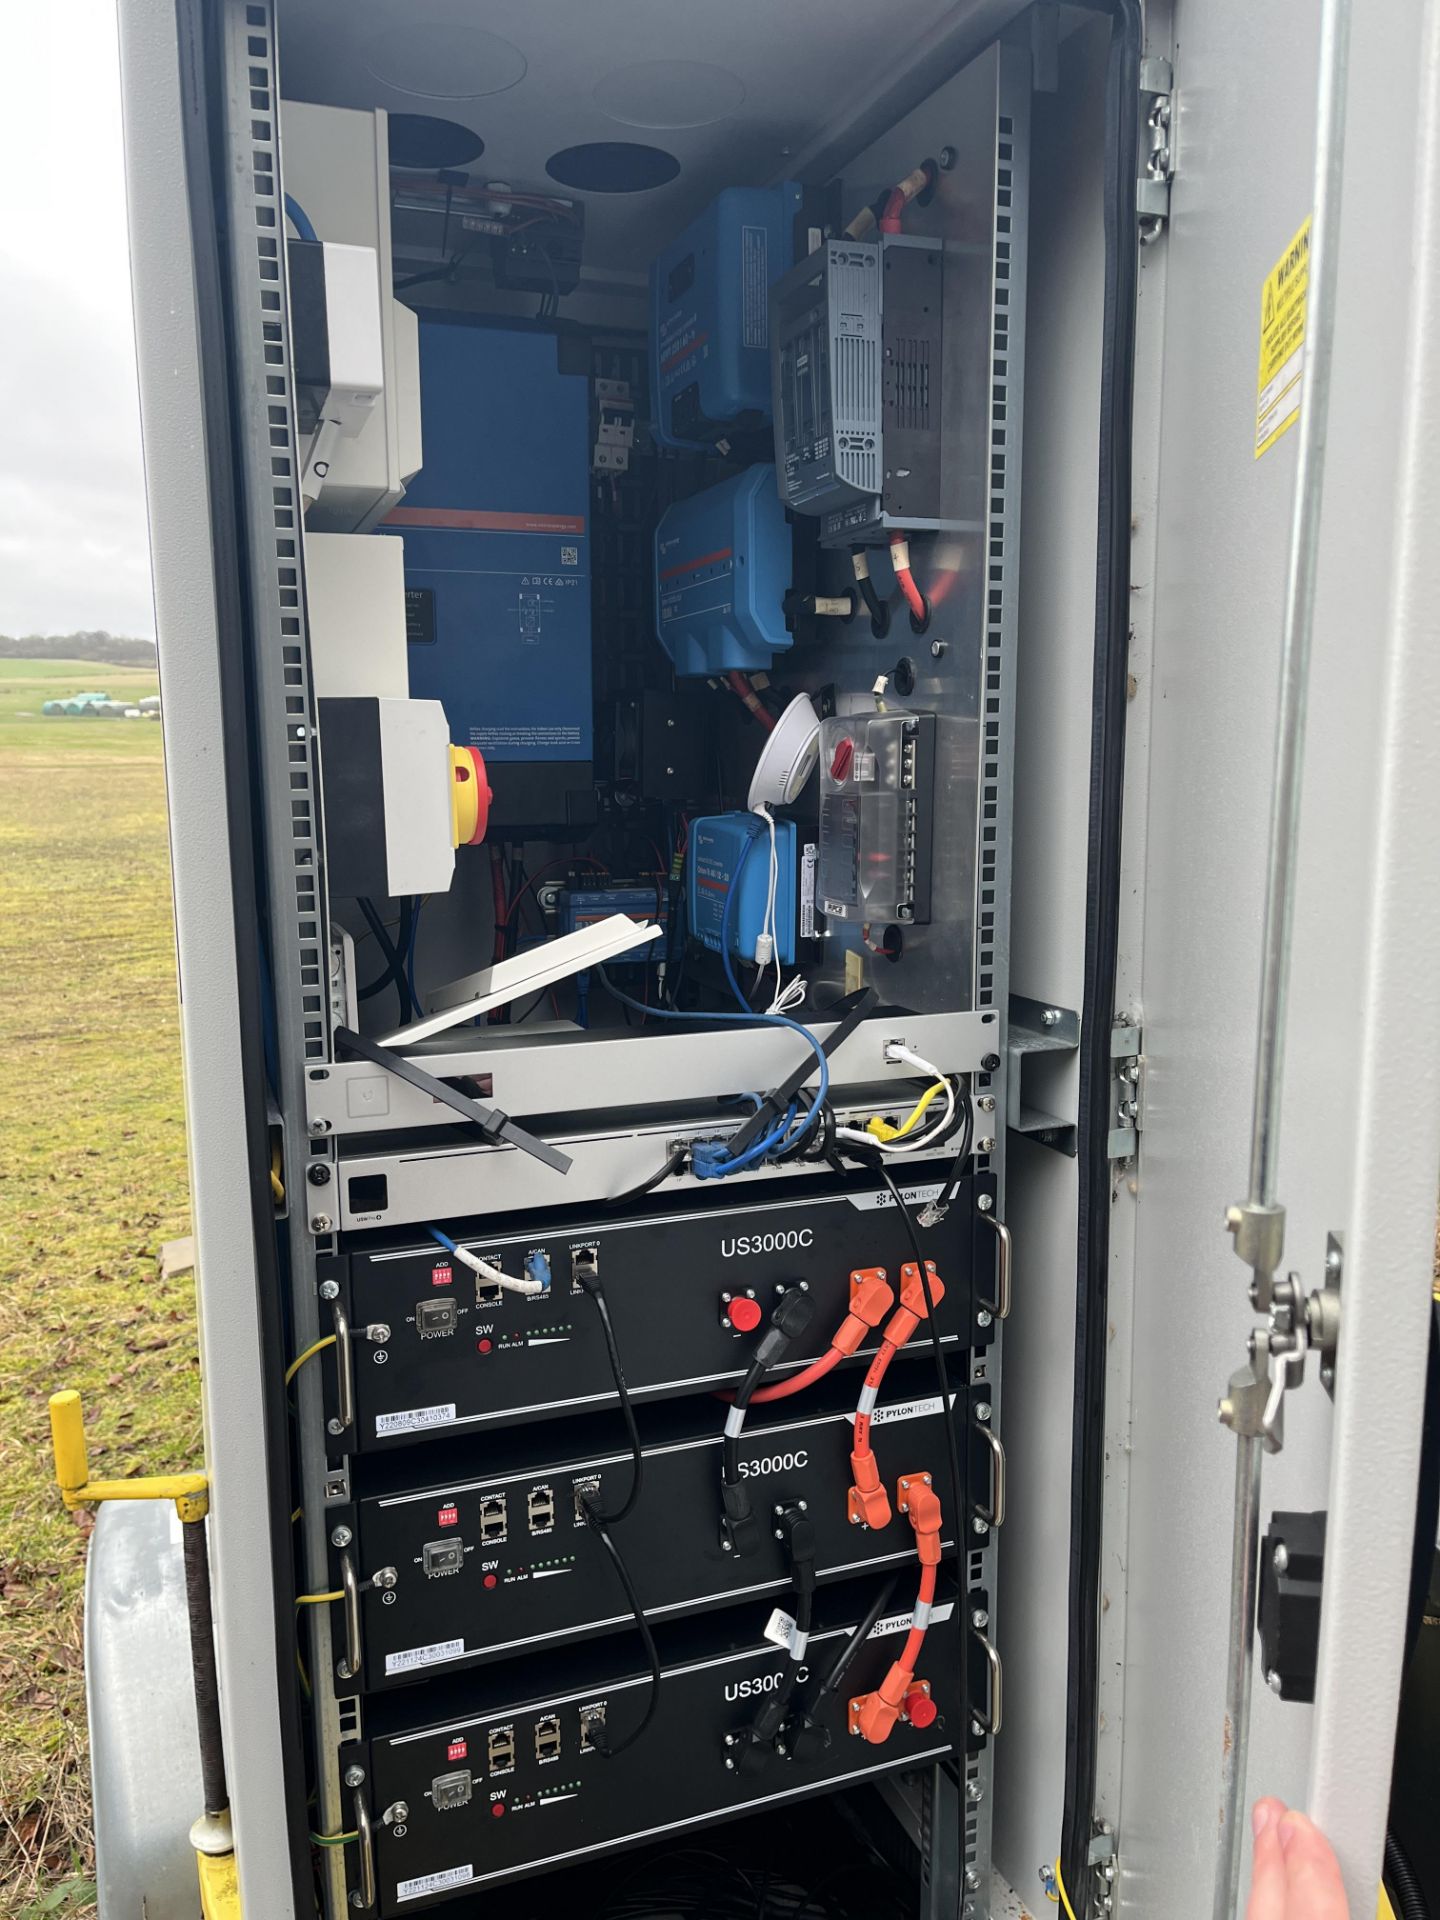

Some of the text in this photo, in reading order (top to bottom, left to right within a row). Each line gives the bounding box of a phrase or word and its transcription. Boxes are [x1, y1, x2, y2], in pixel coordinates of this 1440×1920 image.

[569, 1241, 596, 1250] LINKPORT
[721, 1229, 814, 1257] US3000C
[527, 1294, 550, 1302] B/RS485
[476, 1301, 503, 1310] CONSOLE
[457, 1307, 469, 1315] OFF
[421, 1328, 455, 1341] POWER
[476, 1324, 494, 1335] SW
[886, 1402, 936, 1418] PYLONTECH
[722, 1451, 809, 1479] S3000C
[572, 1474, 597, 1484] LINKPORT
[532, 1484, 549, 1492] A/CAN
[480, 1492, 506, 1502] CONTACT
[531, 1527, 552, 1536] B/RS485
[481, 1537, 507, 1546] CONSOLE
[463, 1545, 475, 1553] OFF
[481, 1559, 499, 1571] SW
[428, 1567, 460, 1580] POWER
[503, 1573, 529, 1584] RUN ALM
[725, 1666, 809, 1701] US300C
[578, 1701, 604, 1712] LINKPORT
[540, 1713, 556, 1722] A/CAN
[489, 1724, 513, 1734] CONTACT
[490, 1767, 515, 1777] CONSOLE
[472, 1776, 483, 1784] OFF
[489, 1789, 507, 1801] SW
[523, 1801, 536, 1809] ALM
